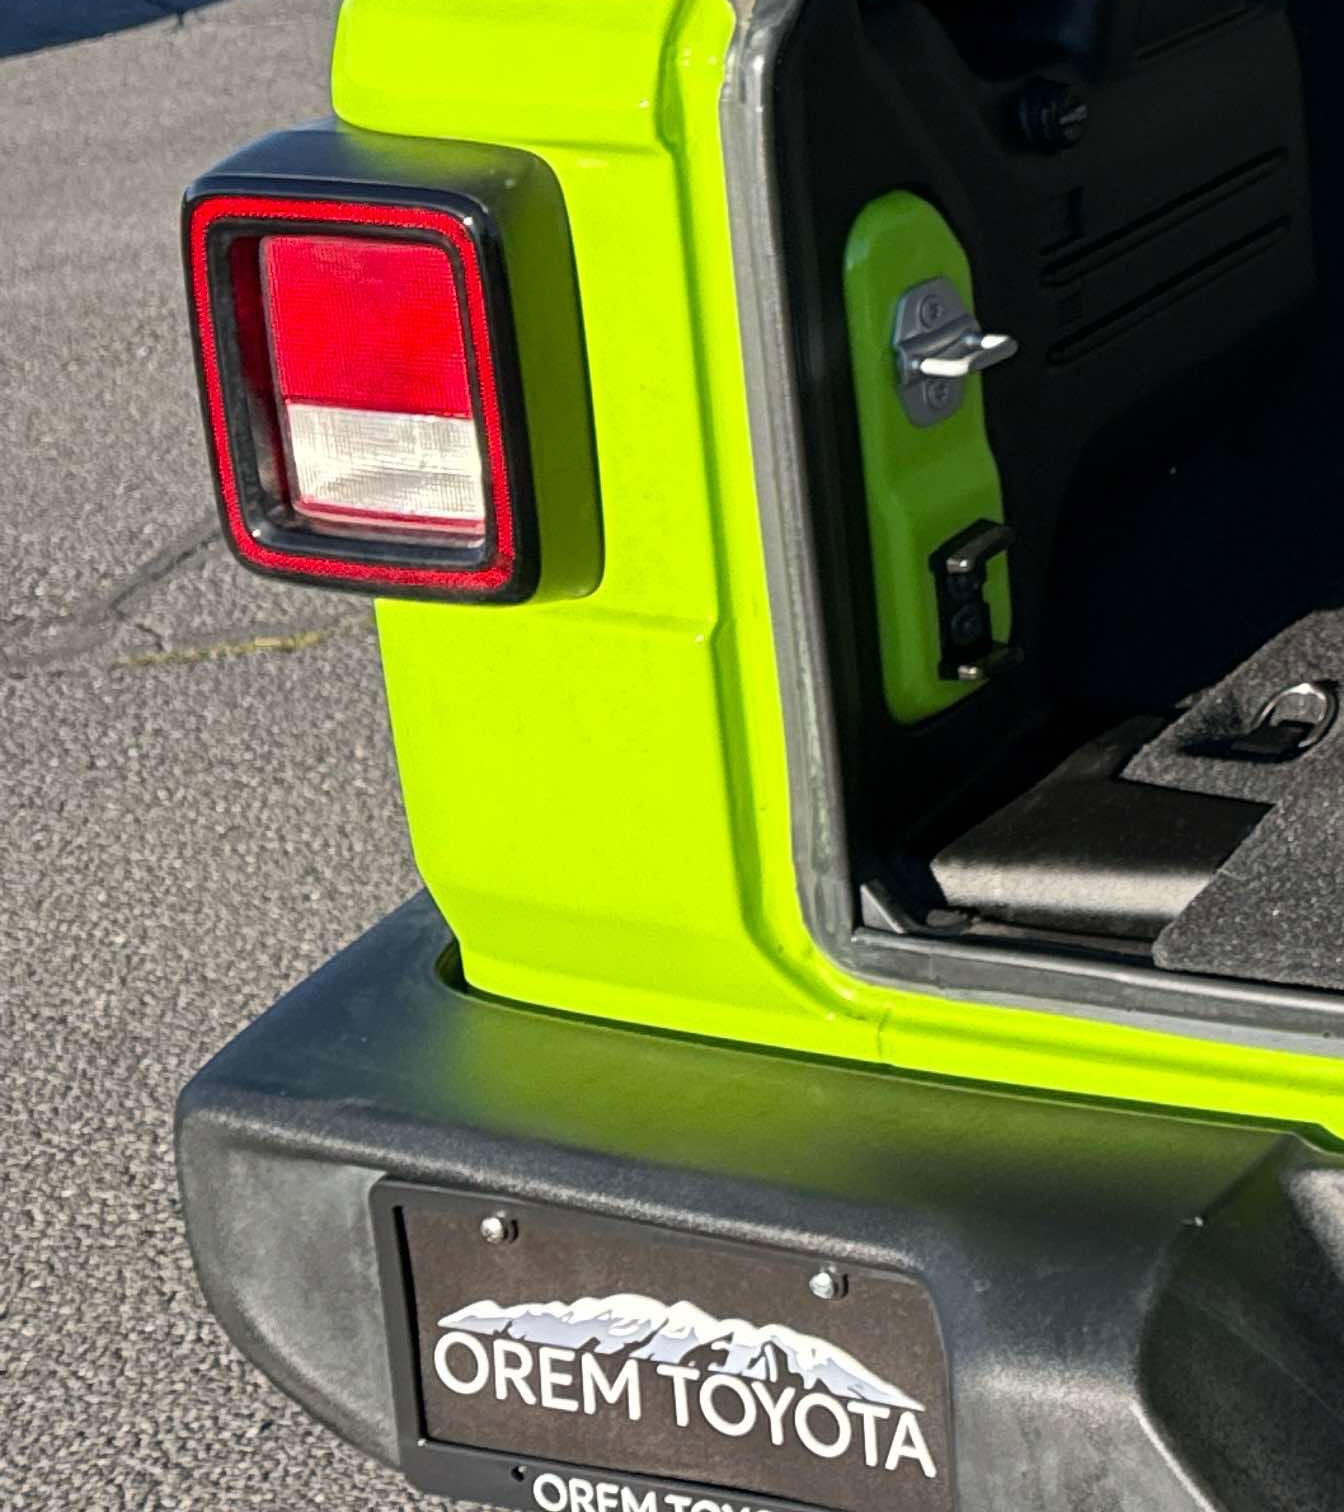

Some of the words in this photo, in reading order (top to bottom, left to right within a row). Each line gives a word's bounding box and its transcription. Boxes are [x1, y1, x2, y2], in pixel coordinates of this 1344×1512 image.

[434, 1331, 641, 1421] OREM
[656, 1364, 937, 1479] TOYOTA
[533, 1473, 656, 1512] OREM
